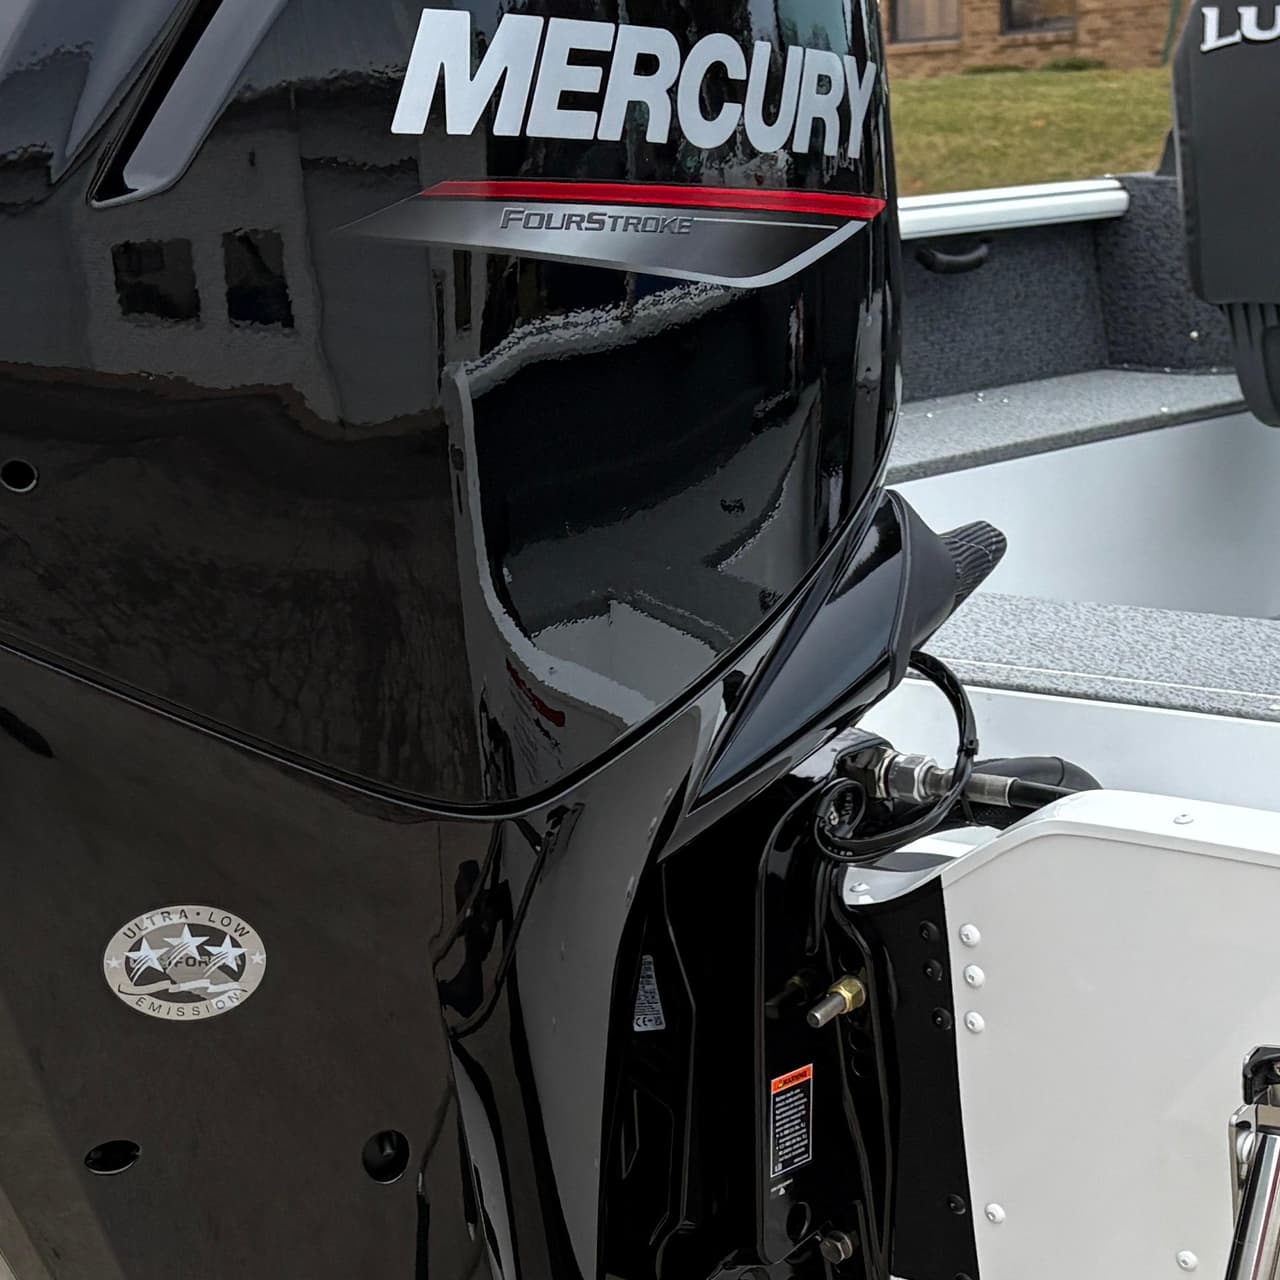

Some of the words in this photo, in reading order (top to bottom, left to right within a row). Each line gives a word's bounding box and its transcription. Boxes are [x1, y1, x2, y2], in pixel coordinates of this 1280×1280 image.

[390, 7, 877, 160] MERCURY
[122, 908, 188, 940] ULTRA
[208, 911, 250, 938] LOW
[134, 991, 241, 1017] EMISSION
